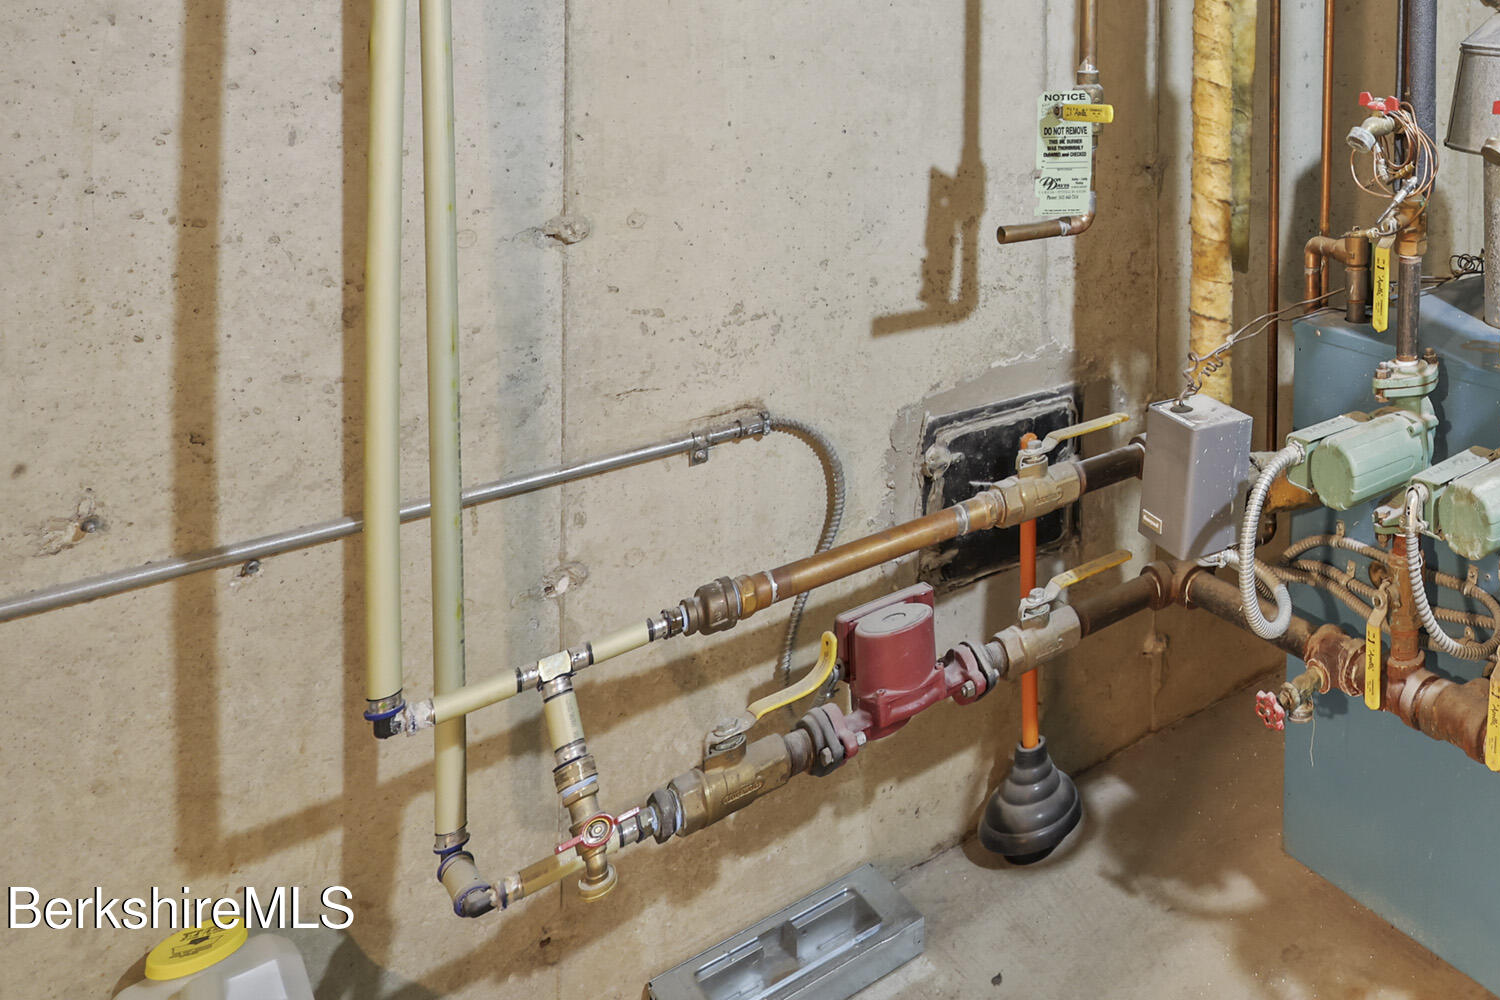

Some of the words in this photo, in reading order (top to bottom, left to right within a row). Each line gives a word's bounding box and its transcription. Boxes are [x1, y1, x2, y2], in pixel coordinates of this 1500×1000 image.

[1044, 93, 1086, 102] NOTICE
[1044, 127, 1053, 136] DO
[1053, 127, 1065, 135] NOT
[1066, 126, 1088, 135] REMOVE
